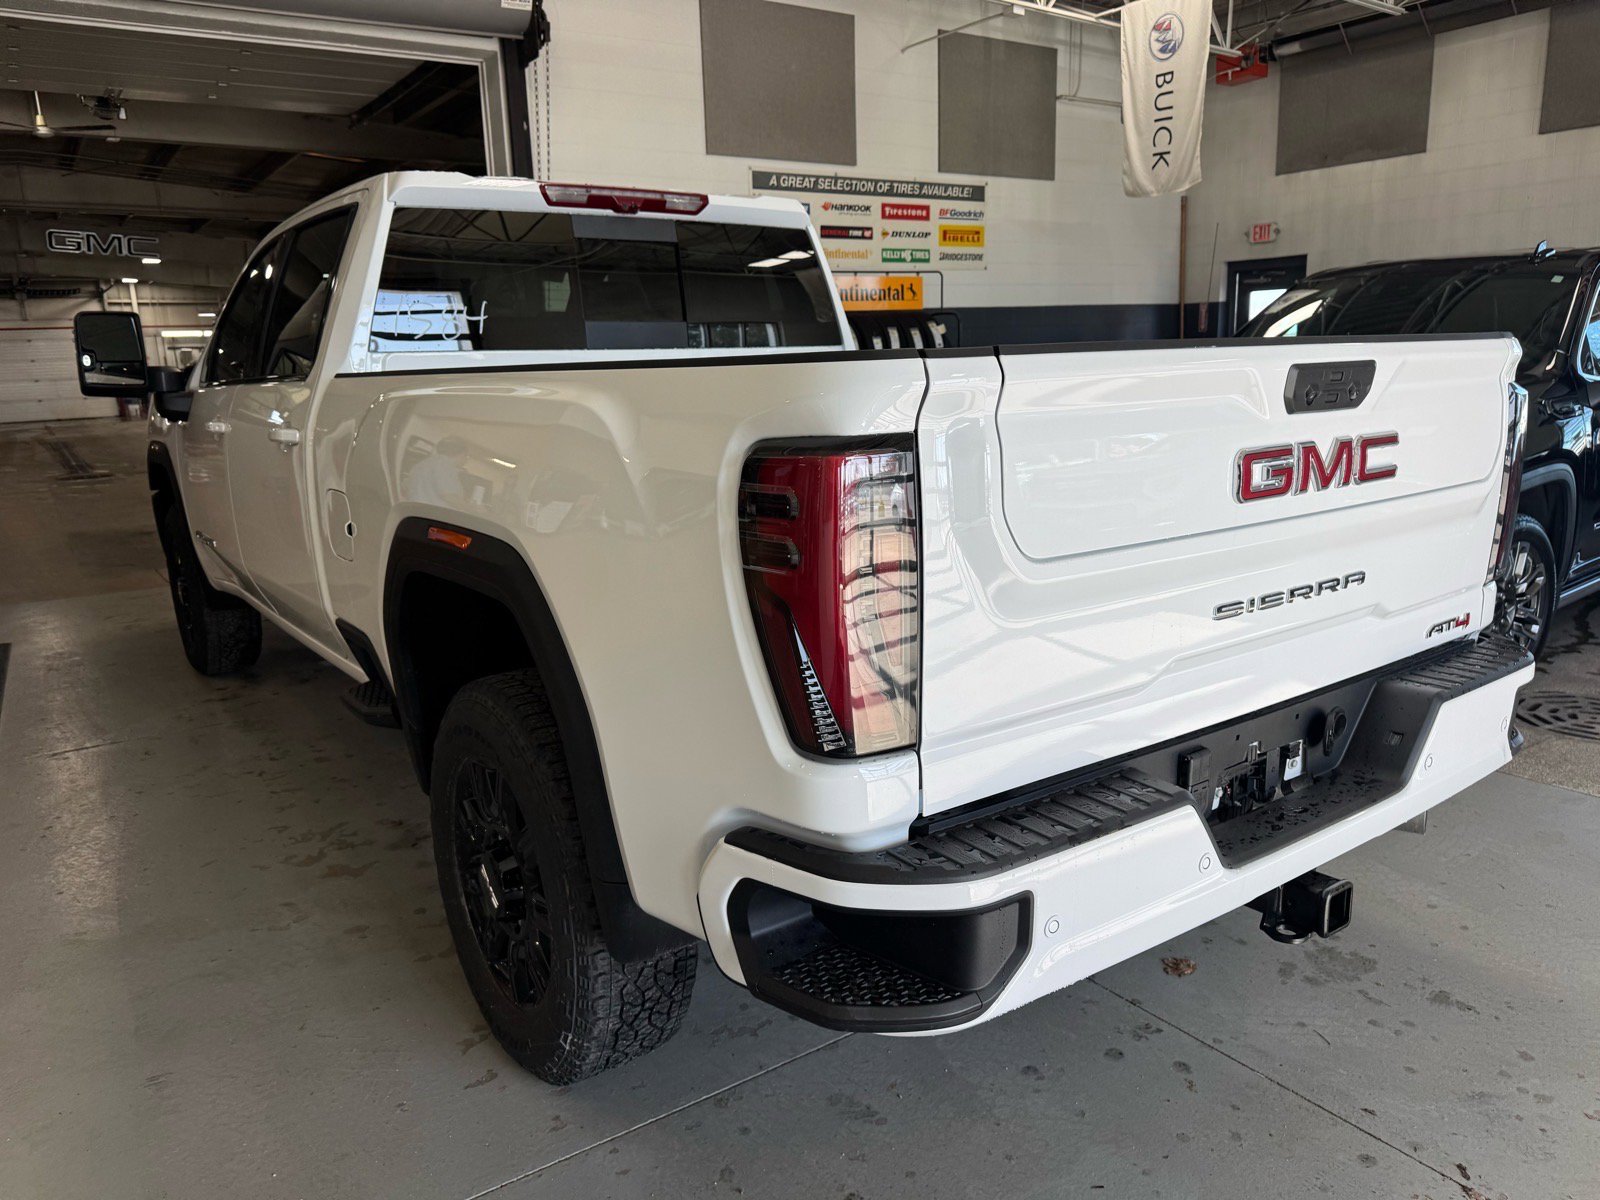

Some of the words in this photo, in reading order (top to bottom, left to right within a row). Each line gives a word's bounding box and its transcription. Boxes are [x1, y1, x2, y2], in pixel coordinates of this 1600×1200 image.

[1151, 70, 1174, 170] BUICK
[769, 174, 778, 187] A
[780, 175, 817, 189] GREAT
[817, 178, 875, 192] SELECTION
[876, 182, 891, 193] OF
[892, 183, 920, 195] TIRES
[921, 184, 973, 198] AVAILABLE!
[939, 208, 984, 218] BFGoodrich
[46, 228, 160, 258] GMC
[891, 231, 931, 239] DUNLOP
[943, 229, 980, 243] PIRELLI
[1253, 224, 1271, 241] EXIT
[939, 252, 984, 262] BRIDGESTONE
[1232, 431, 1399, 504] GMC
[1212, 570, 1366, 621] SIERRA
[1425, 611, 1471, 639] AT4
